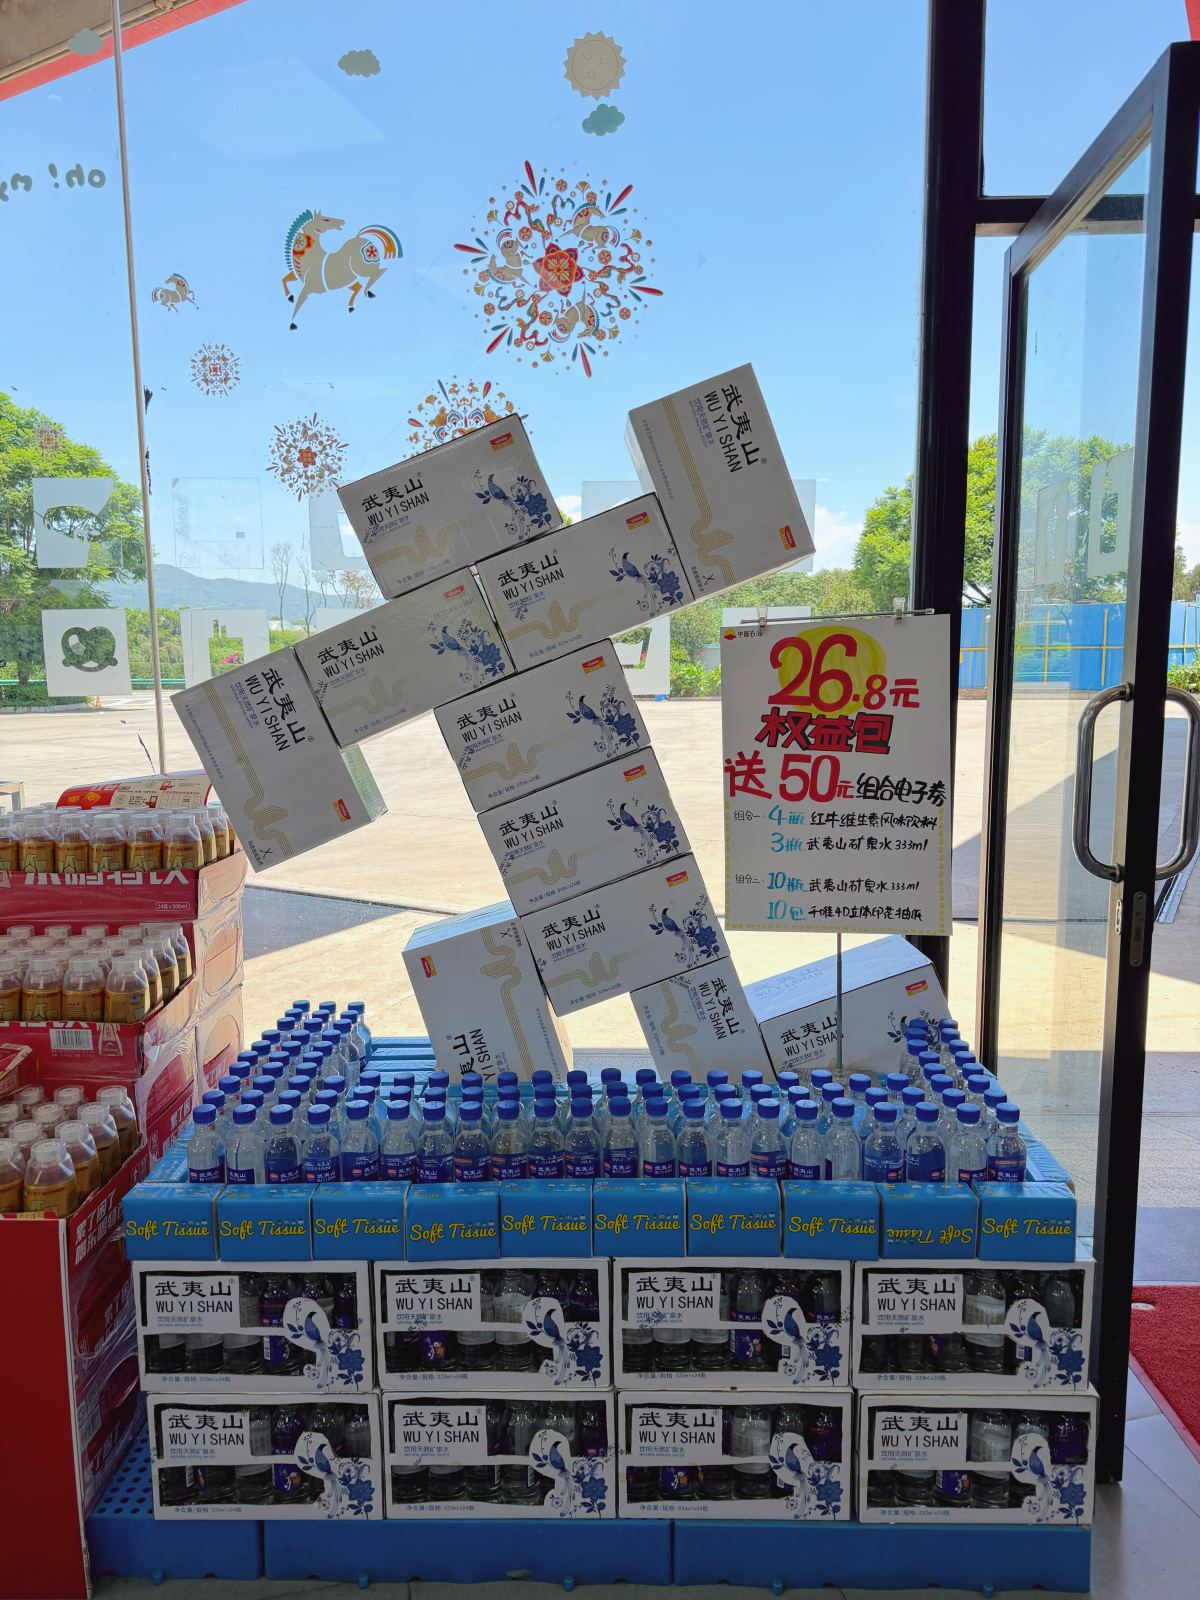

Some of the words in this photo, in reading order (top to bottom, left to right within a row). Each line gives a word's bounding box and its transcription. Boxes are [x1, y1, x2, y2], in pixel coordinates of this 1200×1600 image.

[721, 384, 760, 466] 武夷山
[361, 478, 424, 513] 武夷山
[497, 554, 559, 588] 武夷山
[317, 630, 379, 665] 武夷山
[261, 668, 306, 745] 武夷山
[456, 697, 517, 731] 武夷山
[754, 706, 895, 755] 权益包
[499, 805, 559, 837] 武夷山
[541, 908, 601, 939] 武夷山
[711, 977, 740, 1035] 武夷山
[781, 1016, 838, 1045] 武夷山
[125, 1220, 158, 1240] Soft
[162, 1220, 209, 1236] Tissue
[219, 1220, 252, 1240] Soft
[257, 1221, 305, 1236] Tissue
[313, 1218, 347, 1238] Soft
[352, 1218, 400, 1234] Tissue
[409, 1224, 444, 1244] Soft
[449, 1222, 496, 1239] Tissue
[501, 1215, 535, 1235] Soft
[539, 1215, 587, 1231] Tissue
[594, 1213, 629, 1234] Soft
[632, 1214, 680, 1231] Tissue
[689, 1213, 725, 1233] Soft
[728, 1214, 776, 1230] Tissue
[788, 1216, 825, 1237] Soft
[829, 1217, 876, 1234] Tissue
[982, 1217, 1018, 1237] Soft
[1023, 1218, 1072, 1236] Tissue
[886, 1227, 935, 1244] Tissue
[939, 1224, 974, 1245] Soft
[155, 1281, 232, 1298] 武夷山
[395, 1278, 472, 1295] 武夷山
[636, 1276, 713, 1293] 武夷山
[877, 1278, 956, 1295] 武夷山
[156, 1301, 174, 1313] WU
[198, 1300, 233, 1313] SHAN
[396, 1297, 413, 1310] WU
[438, 1297, 473, 1310] SHAN
[637, 1296, 654, 1309] WU
[679, 1296, 713, 1309] SHAN
[878, 1298, 896, 1311] WU
[920, 1298, 956, 1311] SHAN
[168, 1414, 244, 1430] 武夷山
[402, 1411, 479, 1427] 武夷山
[639, 1412, 715, 1428] 武夷山
[881, 1416, 959, 1432] 武夷山
[169, 1433, 187, 1446] WU
[210, 1433, 244, 1446] SHAN
[403, 1430, 421, 1443] WU
[444, 1430, 479, 1443] SHAN
[639, 1431, 657, 1444] WU
[680, 1431, 716, 1444] SHAN
[881, 1435, 899, 1448] WU
[923, 1435, 959, 1448] SHAN
